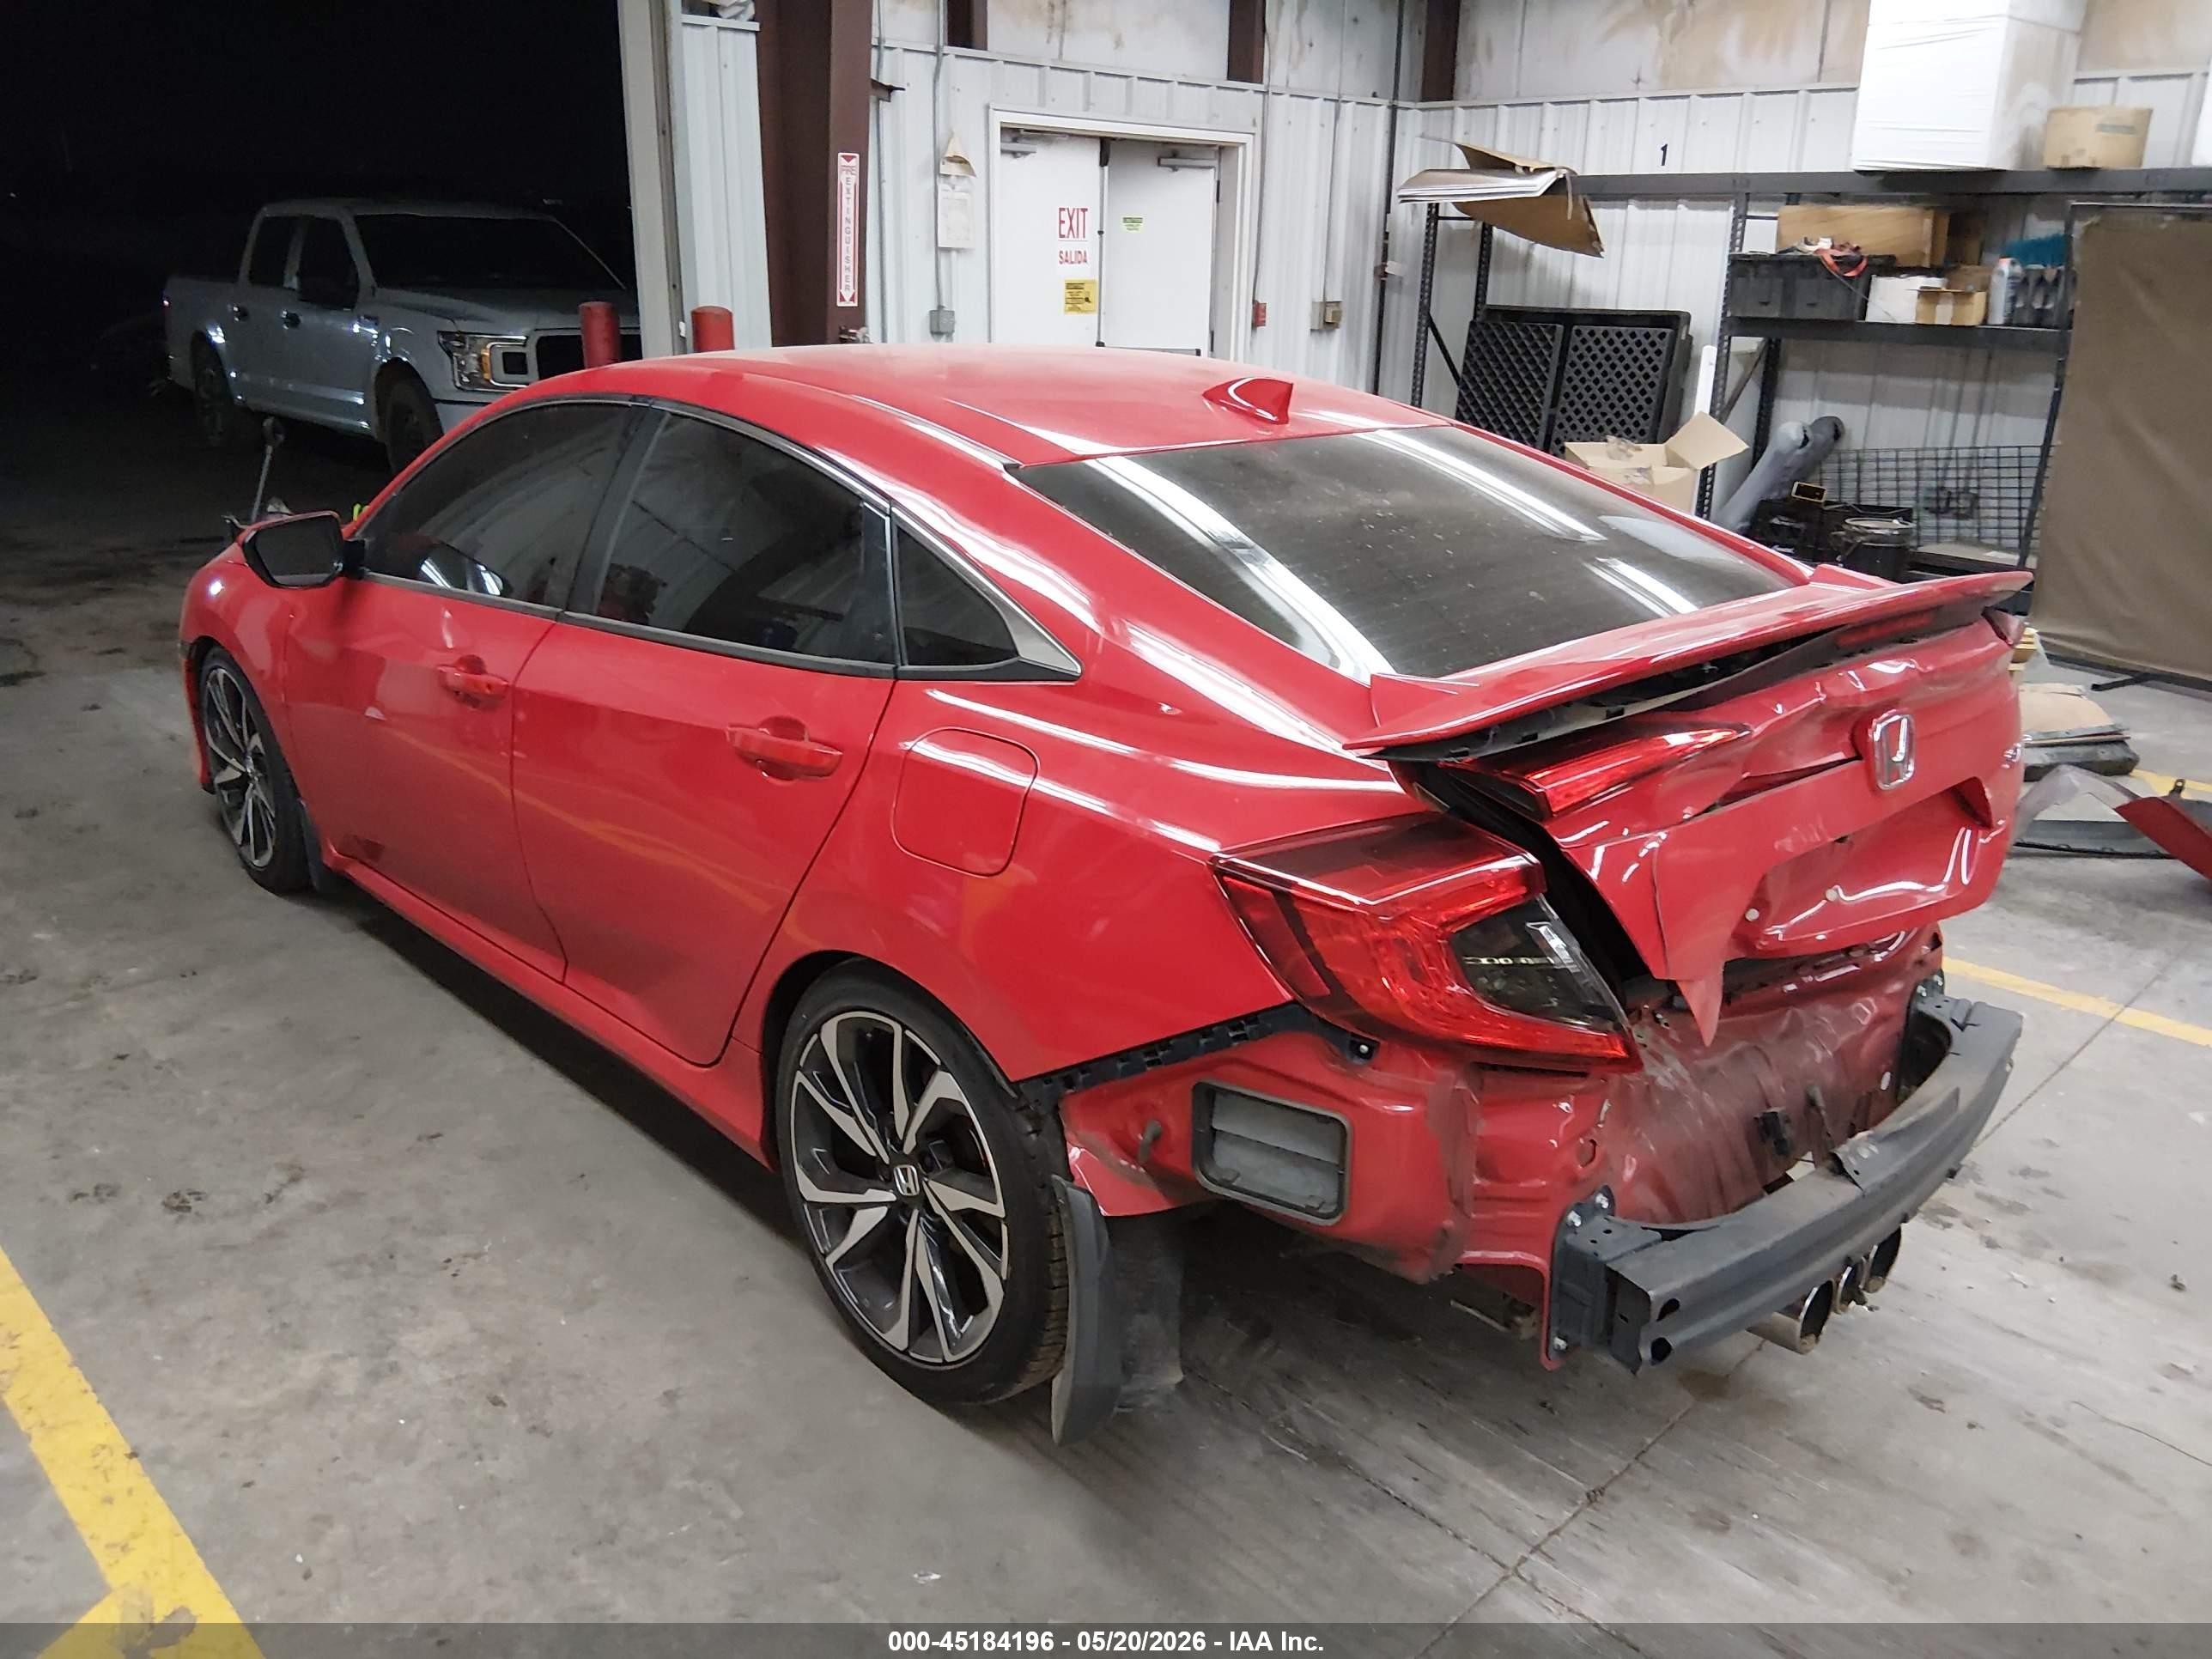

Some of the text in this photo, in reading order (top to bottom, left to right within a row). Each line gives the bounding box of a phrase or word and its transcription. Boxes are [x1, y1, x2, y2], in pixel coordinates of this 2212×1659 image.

[1661, 143, 1668, 167] 1
[1058, 207, 1089, 239] EXIT
[1058, 250, 1089, 265] SALIDA
